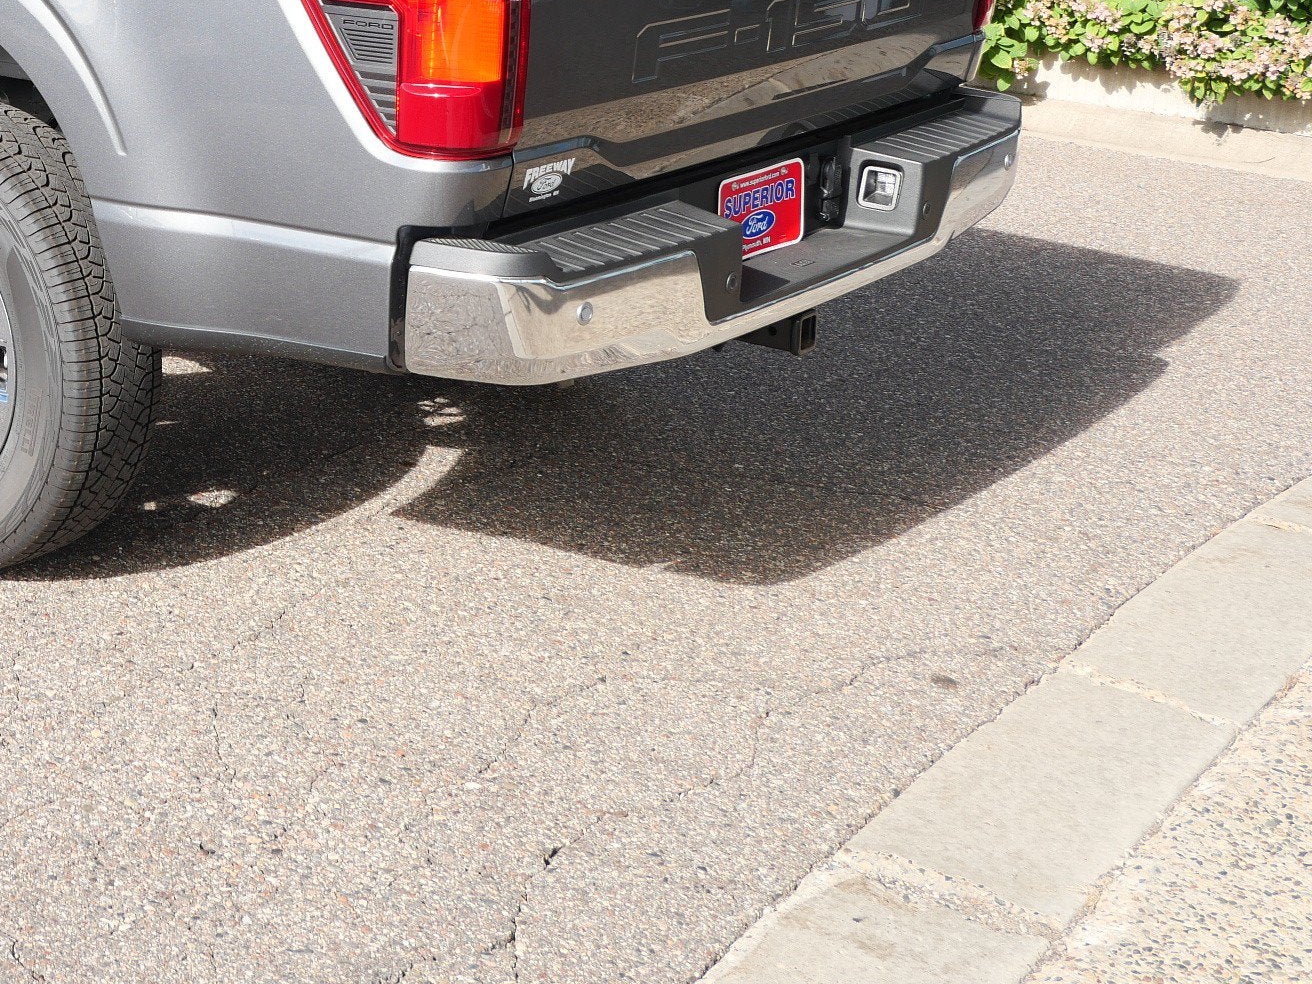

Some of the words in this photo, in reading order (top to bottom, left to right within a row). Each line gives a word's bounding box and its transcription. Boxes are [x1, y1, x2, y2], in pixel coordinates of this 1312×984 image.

[343, 19, 394, 30] FORD
[522, 157, 576, 191] FREEWAY
[724, 178, 796, 219] SUPERIOR
[745, 214, 769, 236] Ford
